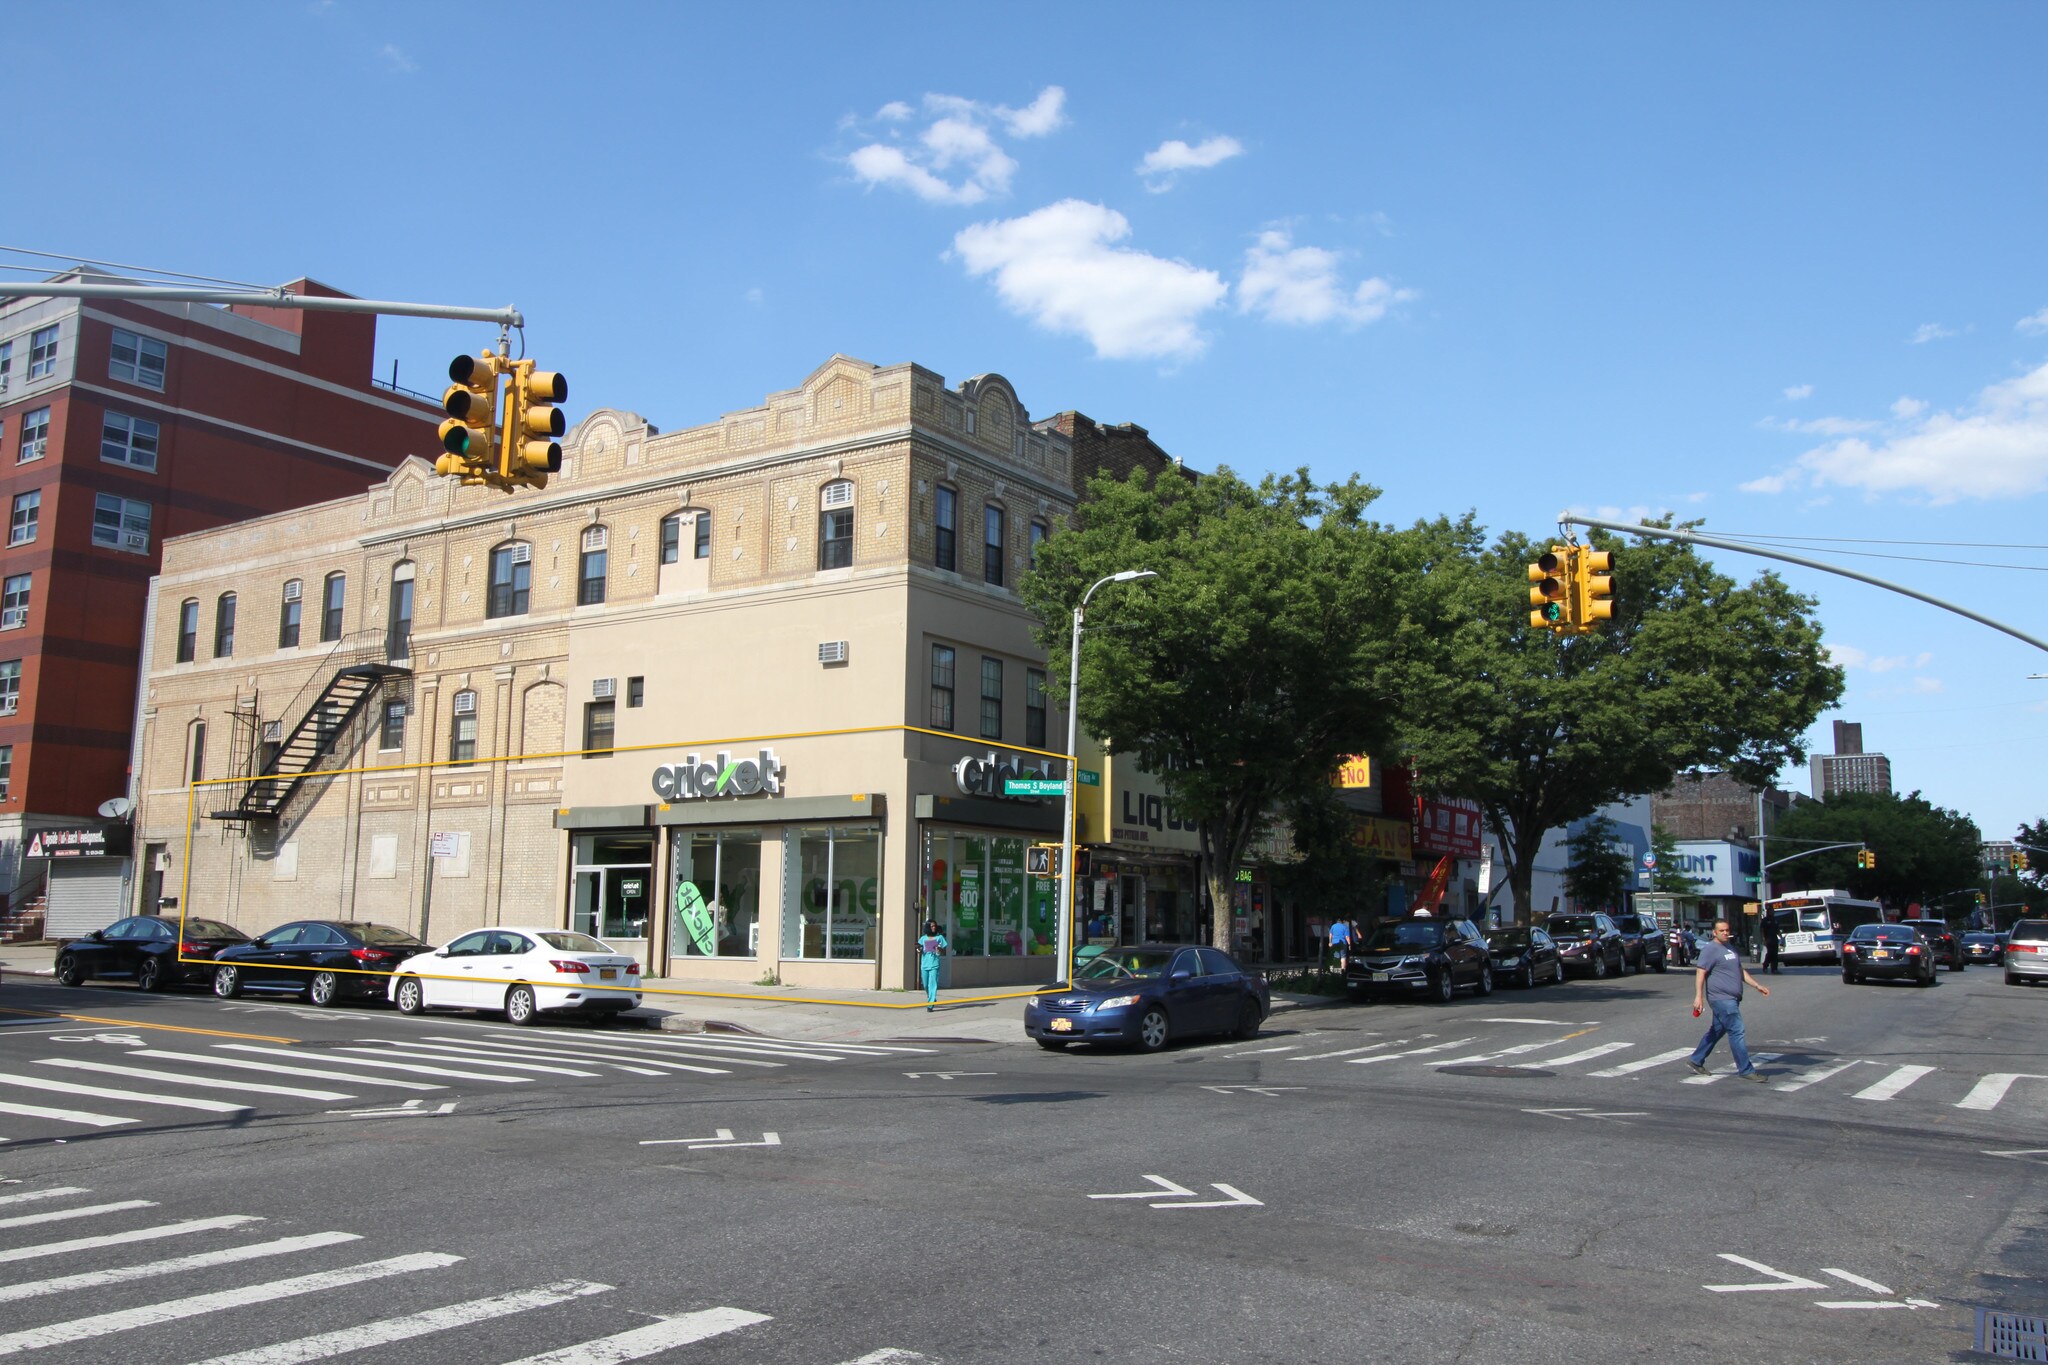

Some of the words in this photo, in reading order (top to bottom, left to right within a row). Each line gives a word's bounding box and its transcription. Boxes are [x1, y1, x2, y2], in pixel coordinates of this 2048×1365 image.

[652, 748, 780, 800] cricket
[1078, 772, 1091, 783] Pitkin
[1331, 767, 1366, 785] PENO
[1008, 781, 1031, 789] Thomas
[1033, 781, 1037, 789] S
[1039, 781, 1063, 791] Boyland
[1240, 870, 1252, 882] BAG
[1035, 881, 1050, 892] FREE
[960, 889, 978, 908] $100
[680, 886, 714, 954] cricket
[991, 934, 1007, 944] FRE
